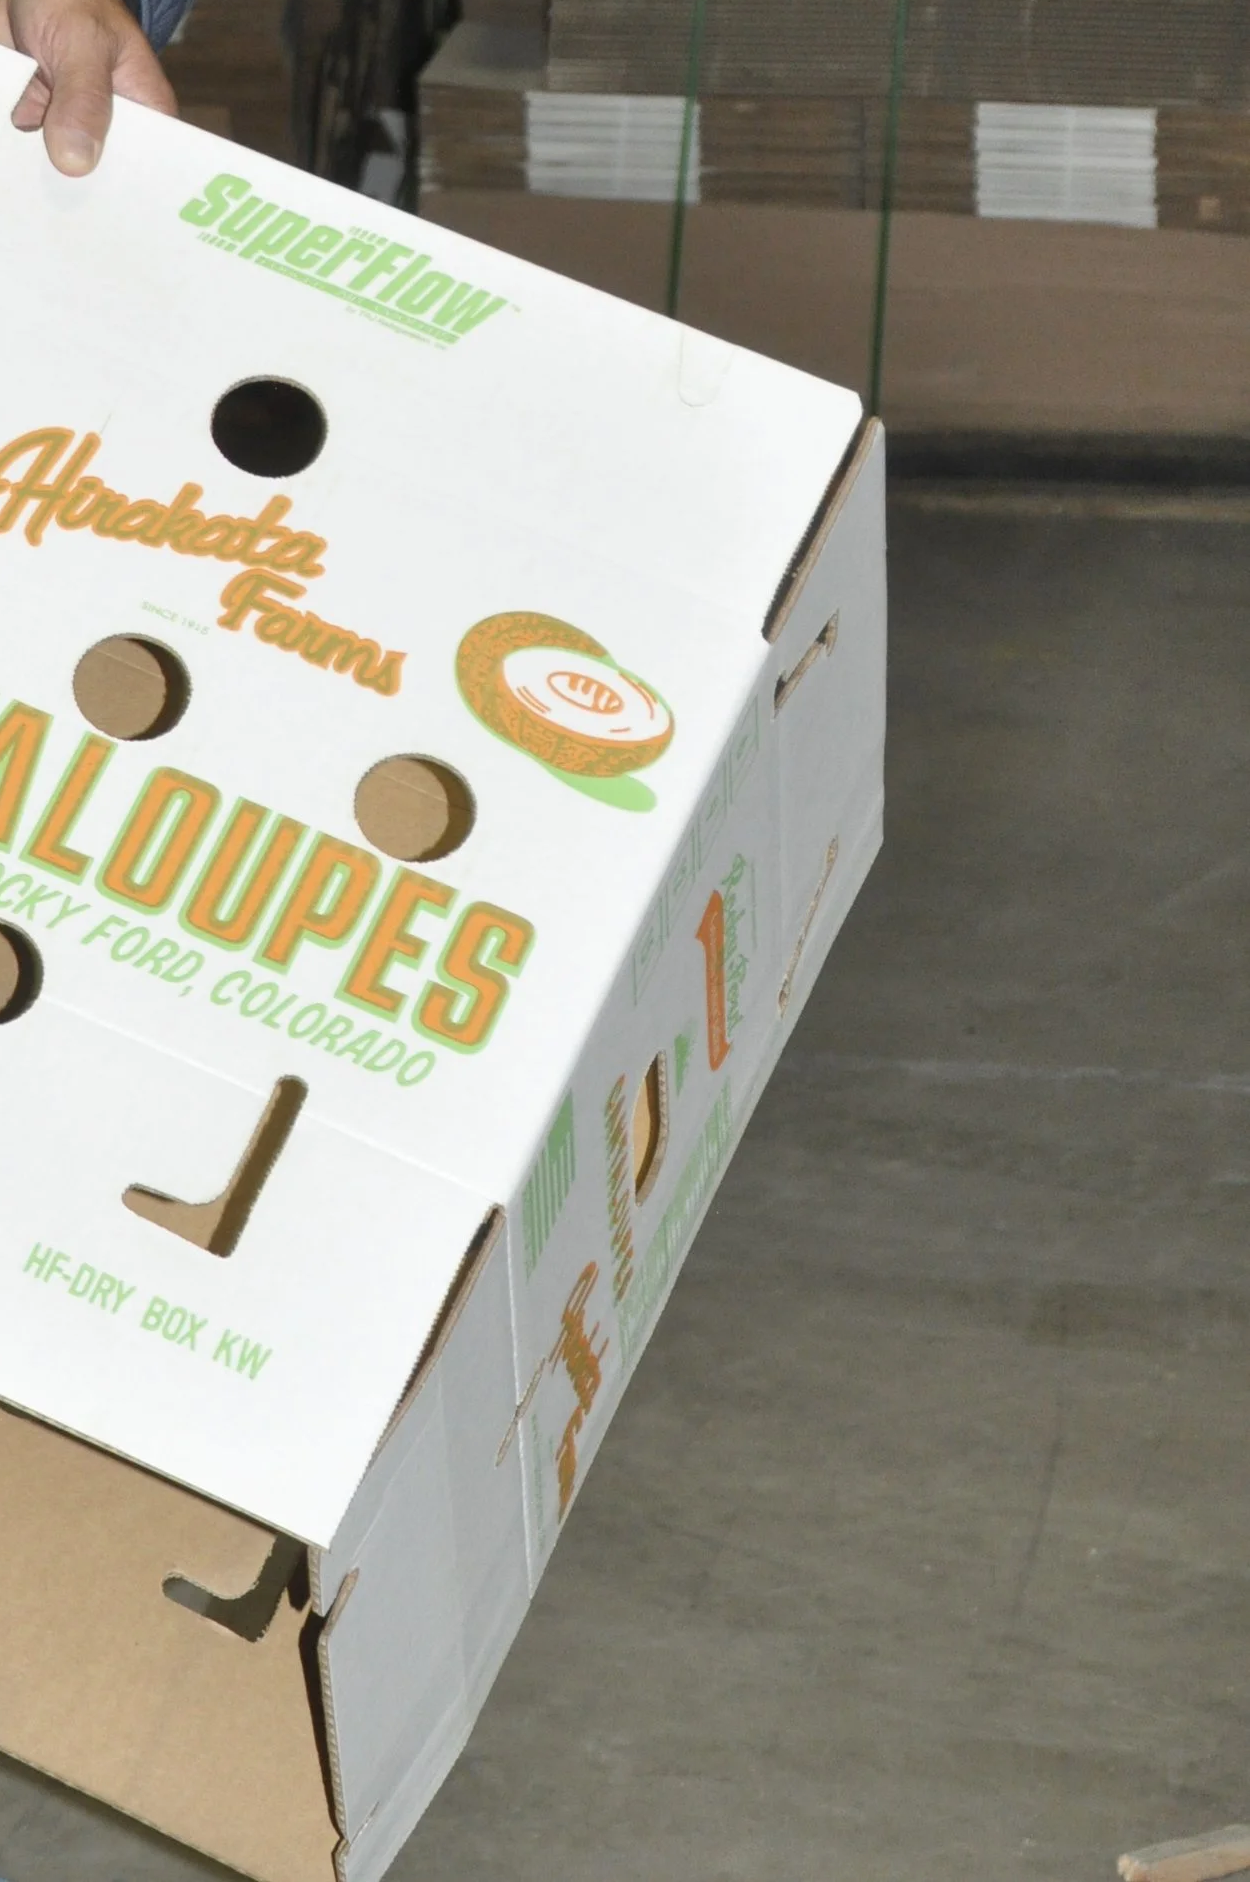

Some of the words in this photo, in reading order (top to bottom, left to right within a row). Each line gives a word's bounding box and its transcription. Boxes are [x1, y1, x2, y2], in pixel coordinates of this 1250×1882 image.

[141, 600, 179, 624] SINCE
[216, 568, 408, 696] Farms
[81, 914, 206, 998] FORD,
[210, 970, 437, 1087] COLORADO
[22, 1242, 137, 1315] HF-DRY
[140, 1295, 208, 1352] BOX
[212, 1329, 273, 1381] KW
